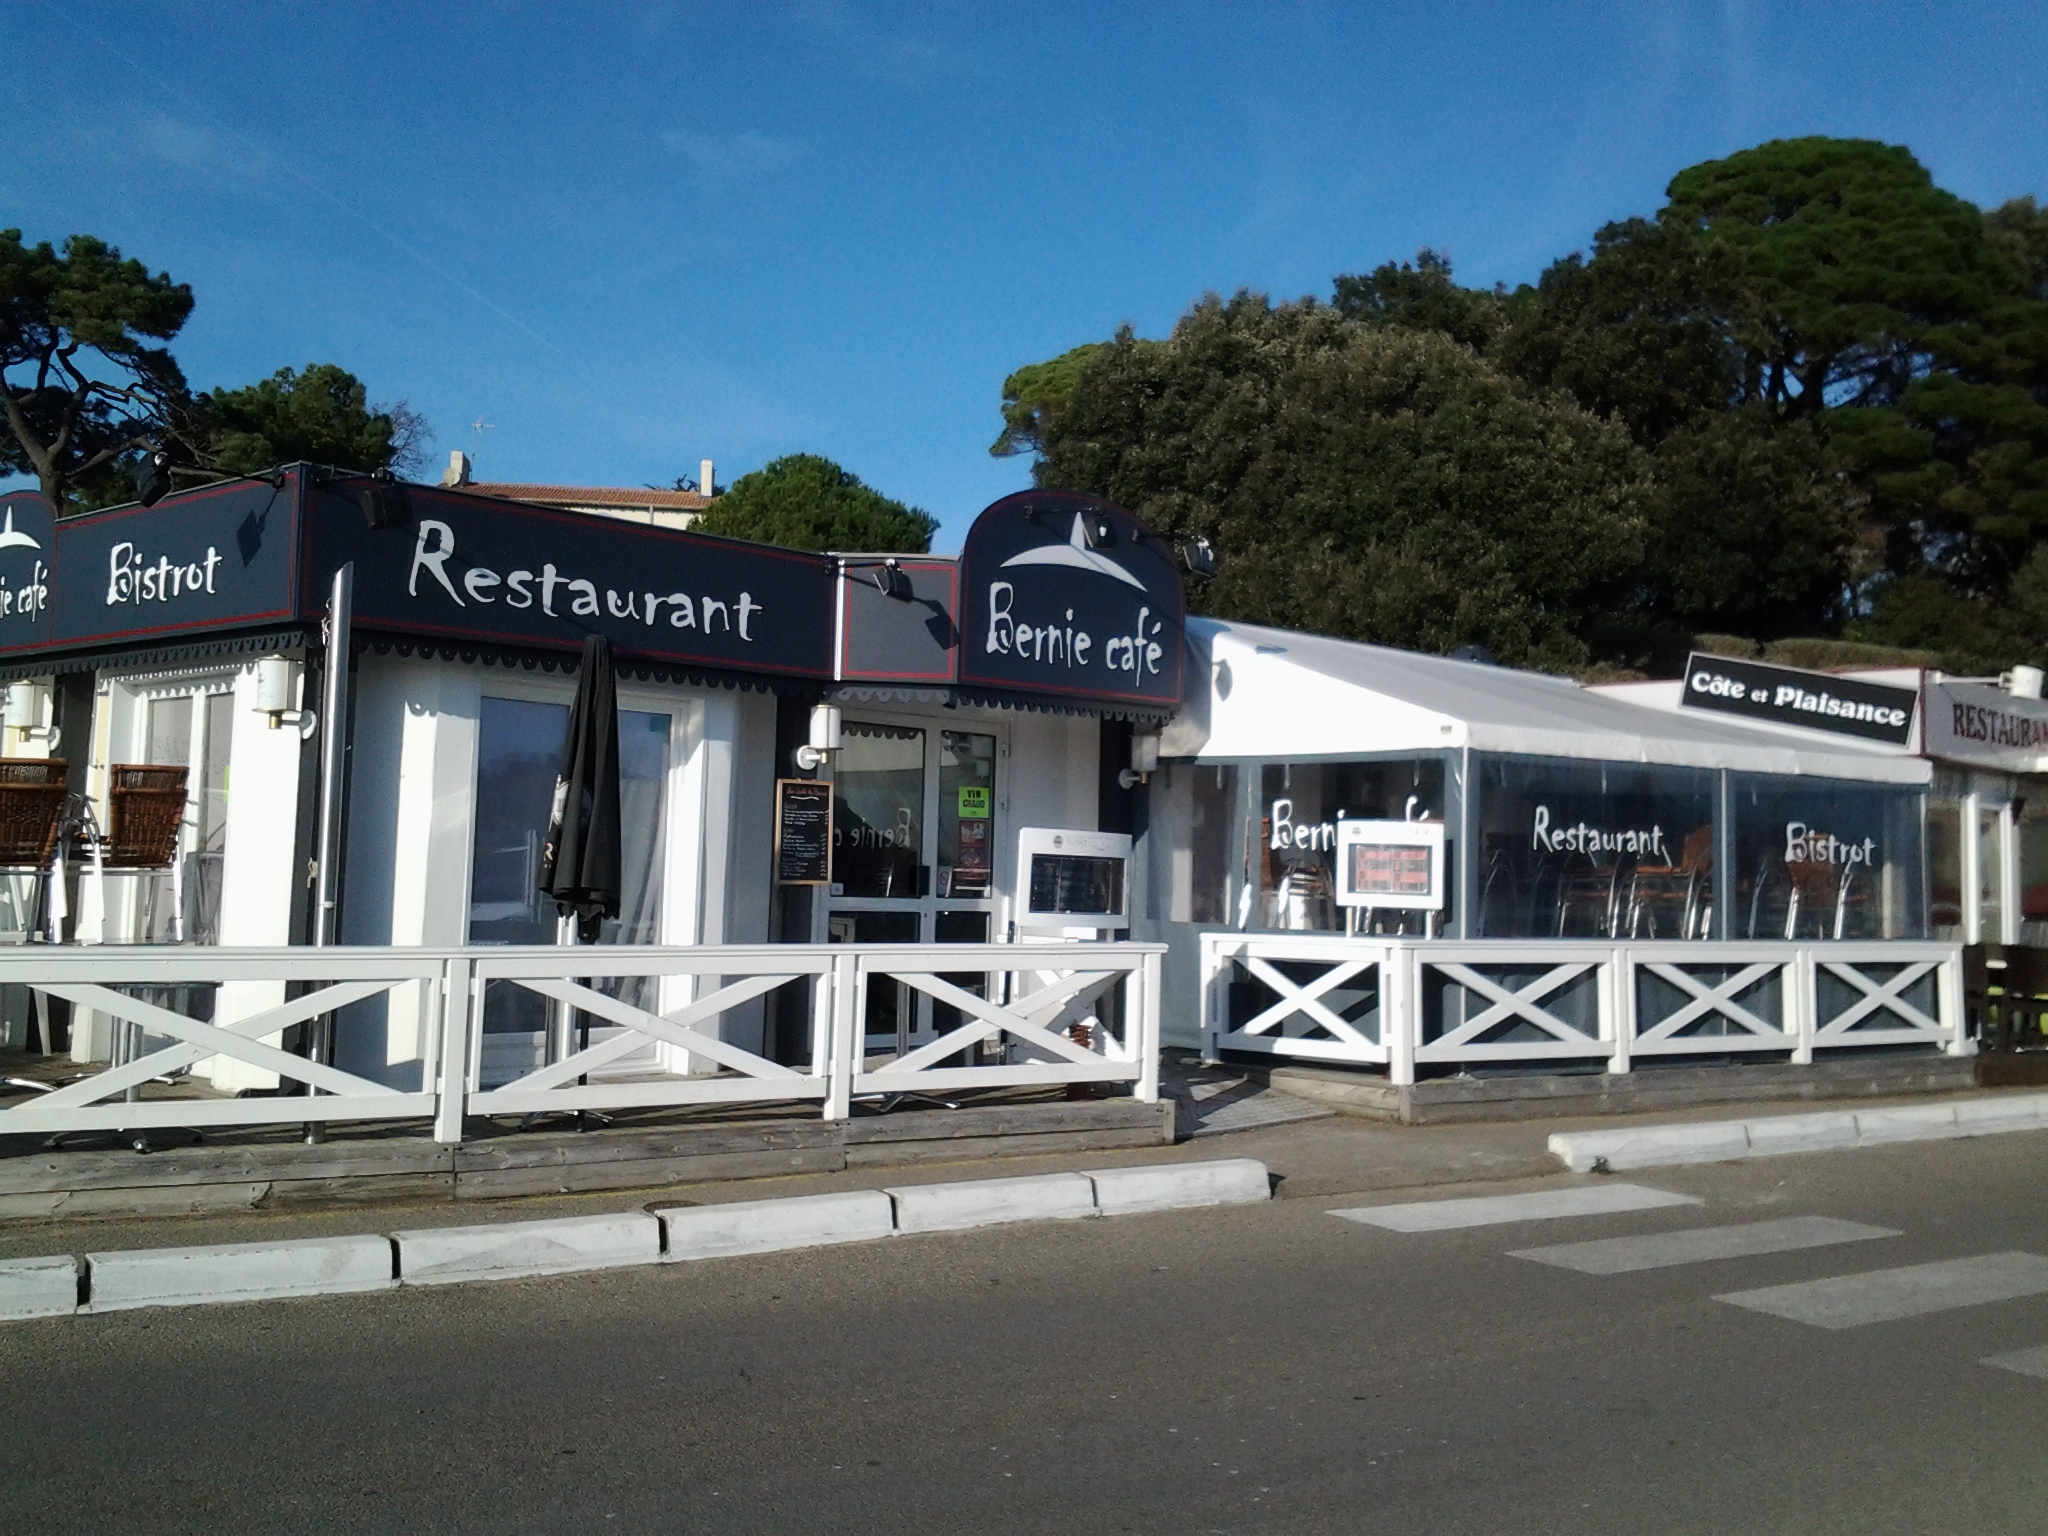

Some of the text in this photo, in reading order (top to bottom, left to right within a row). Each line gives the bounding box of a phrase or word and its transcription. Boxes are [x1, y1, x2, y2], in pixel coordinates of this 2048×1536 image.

[18, 560, 48, 622] café
[107, 542, 222, 606] Bistrot
[409, 519, 763, 642] Restaurant
[986, 581, 1162, 687] Bernie café
[1692, 671, 1746, 699] Côte
[1774, 684, 1907, 727] Plaisance
[1271, 799, 1345, 852] Bern
[1534, 805, 1663, 856] Restaurant
[1785, 821, 1876, 867] Bistrot
